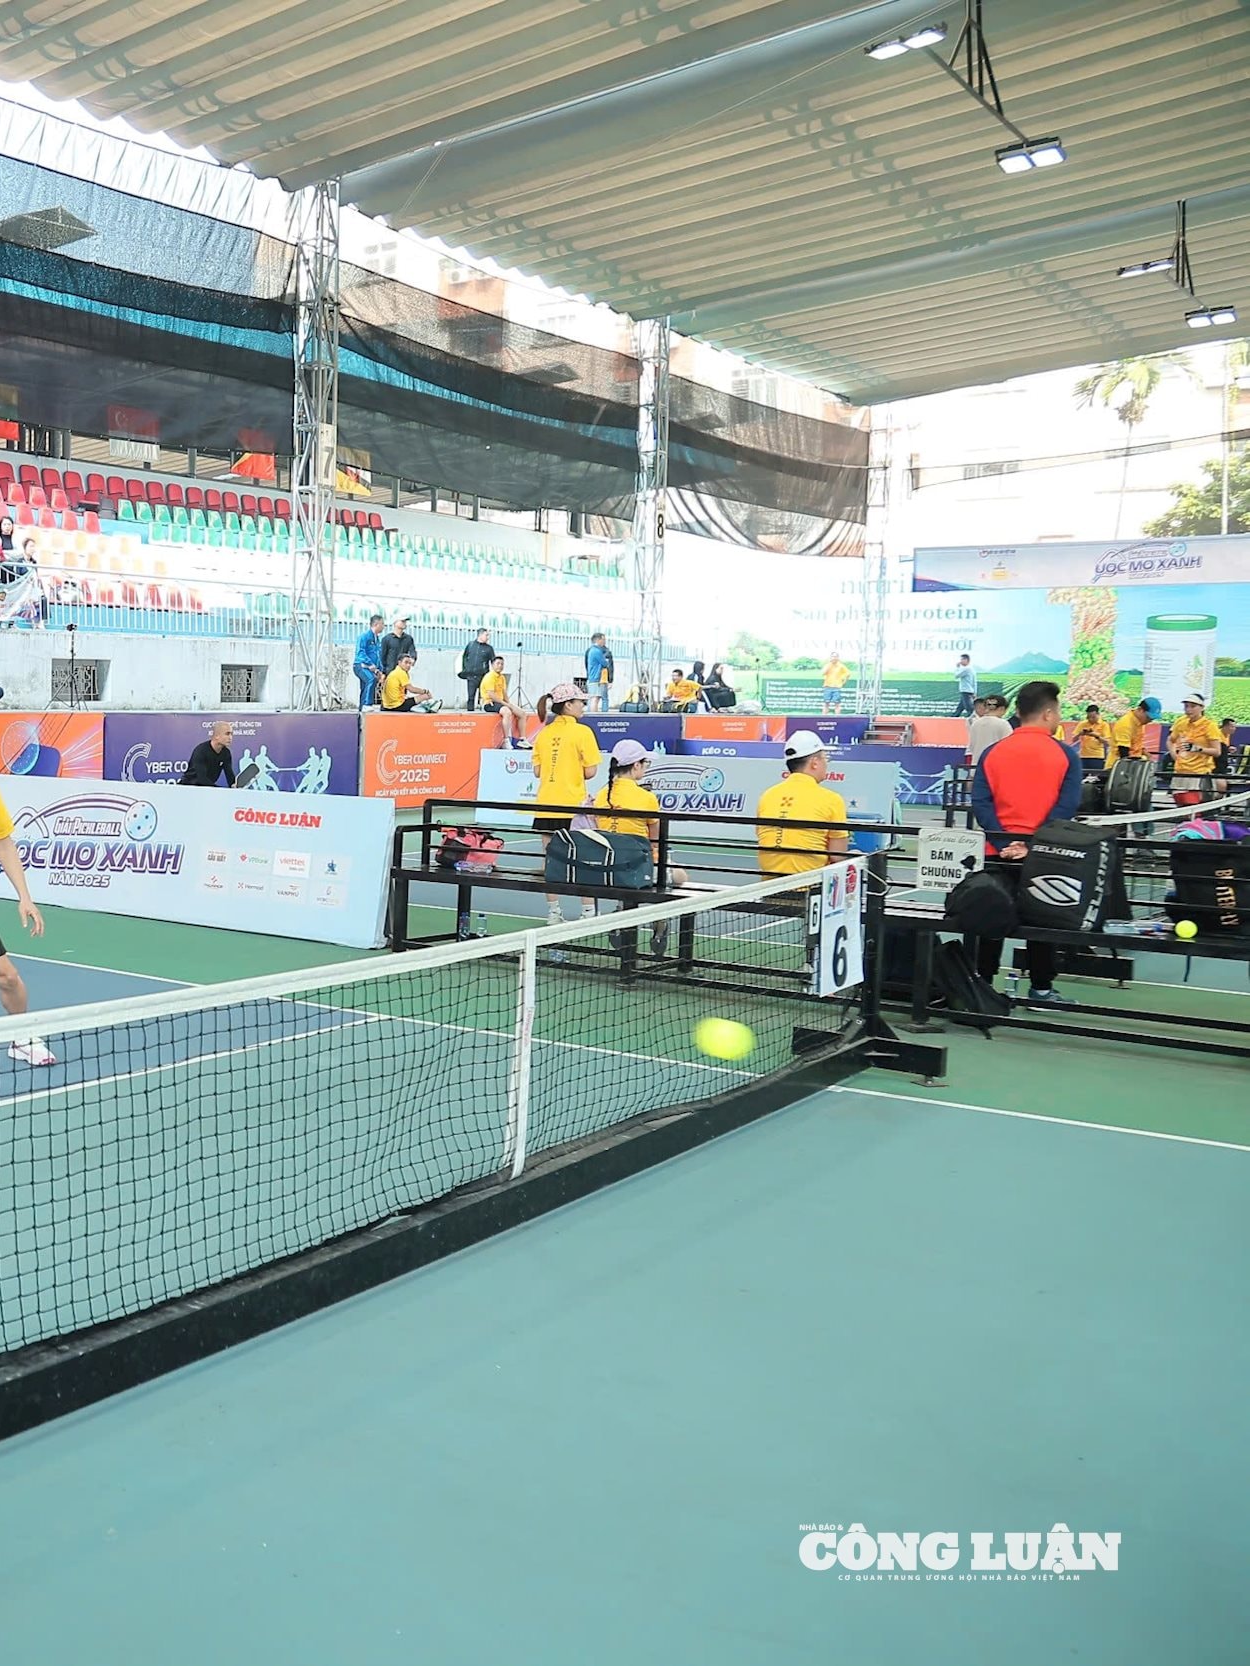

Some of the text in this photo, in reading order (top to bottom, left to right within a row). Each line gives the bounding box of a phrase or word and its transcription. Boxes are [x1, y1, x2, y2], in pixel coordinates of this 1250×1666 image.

[322, 447, 334, 478] 7
[657, 514, 664, 538] 8
[1157, 555, 1203, 569] XANH
[899, 603, 978, 623] protein
[413, 753, 447, 764] CONNECT
[702, 745, 736, 756] KÉO CO
[174, 761, 188, 774] CO
[400, 768, 430, 783] 2025
[679, 793, 745, 812] XANH
[53, 816, 122, 836] GIẢI PICKLEBALL
[234, 808, 322, 829] CÔNG LUẬN
[50, 840, 98, 869] MƠ
[98, 842, 185, 874] XANH
[279, 857, 306, 866] viettel
[1031, 844, 1088, 860] SELKIRK
[49, 872, 111, 887] NĂM 2025
[812, 902, 819, 928] 6
[832, 925, 849, 988] 6
